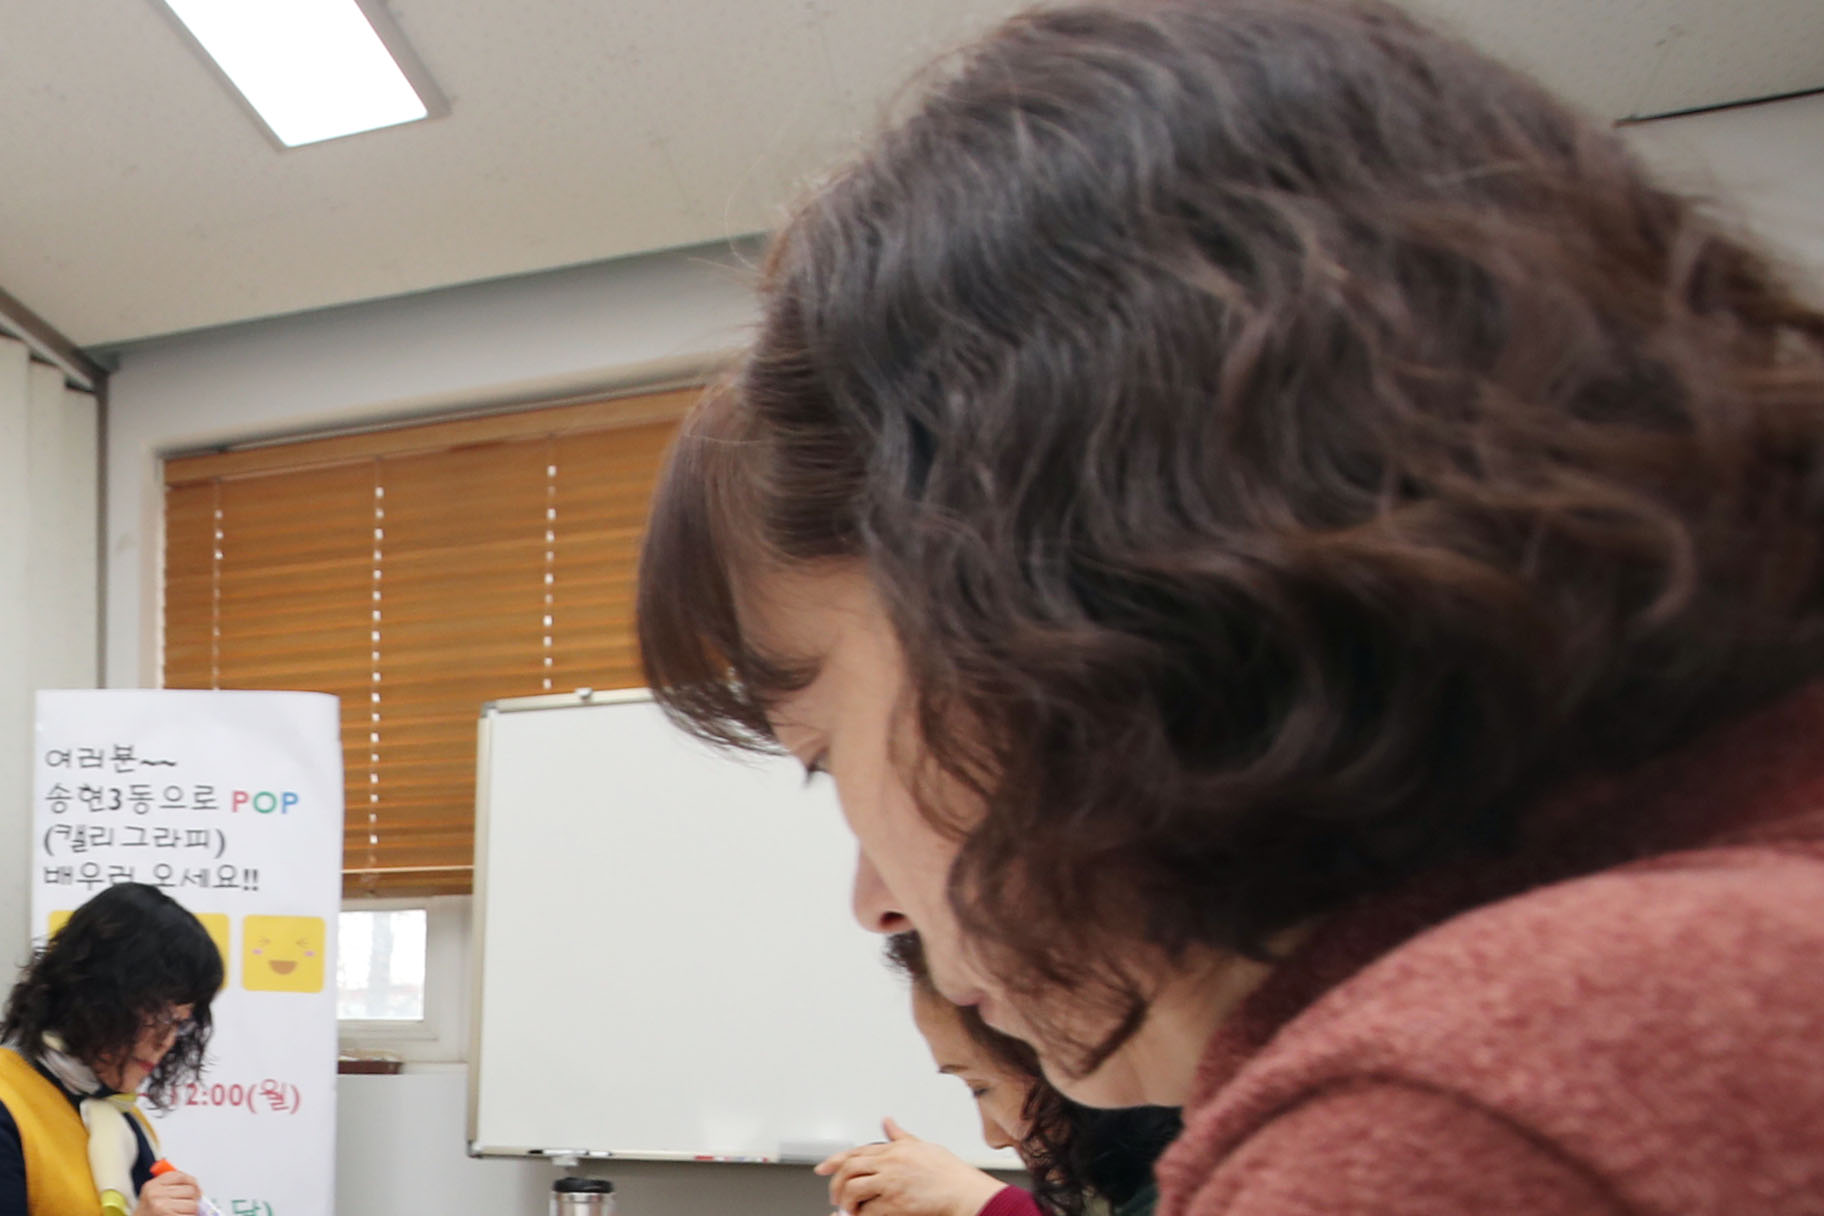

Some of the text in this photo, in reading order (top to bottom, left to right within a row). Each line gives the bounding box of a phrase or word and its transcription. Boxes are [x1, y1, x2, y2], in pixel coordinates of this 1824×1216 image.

[44, 782, 300, 816] 송현3동으로 POP
[43, 823, 226, 860] (캘리그라피)
[42, 861, 260, 892] 배우러 오세요!!
